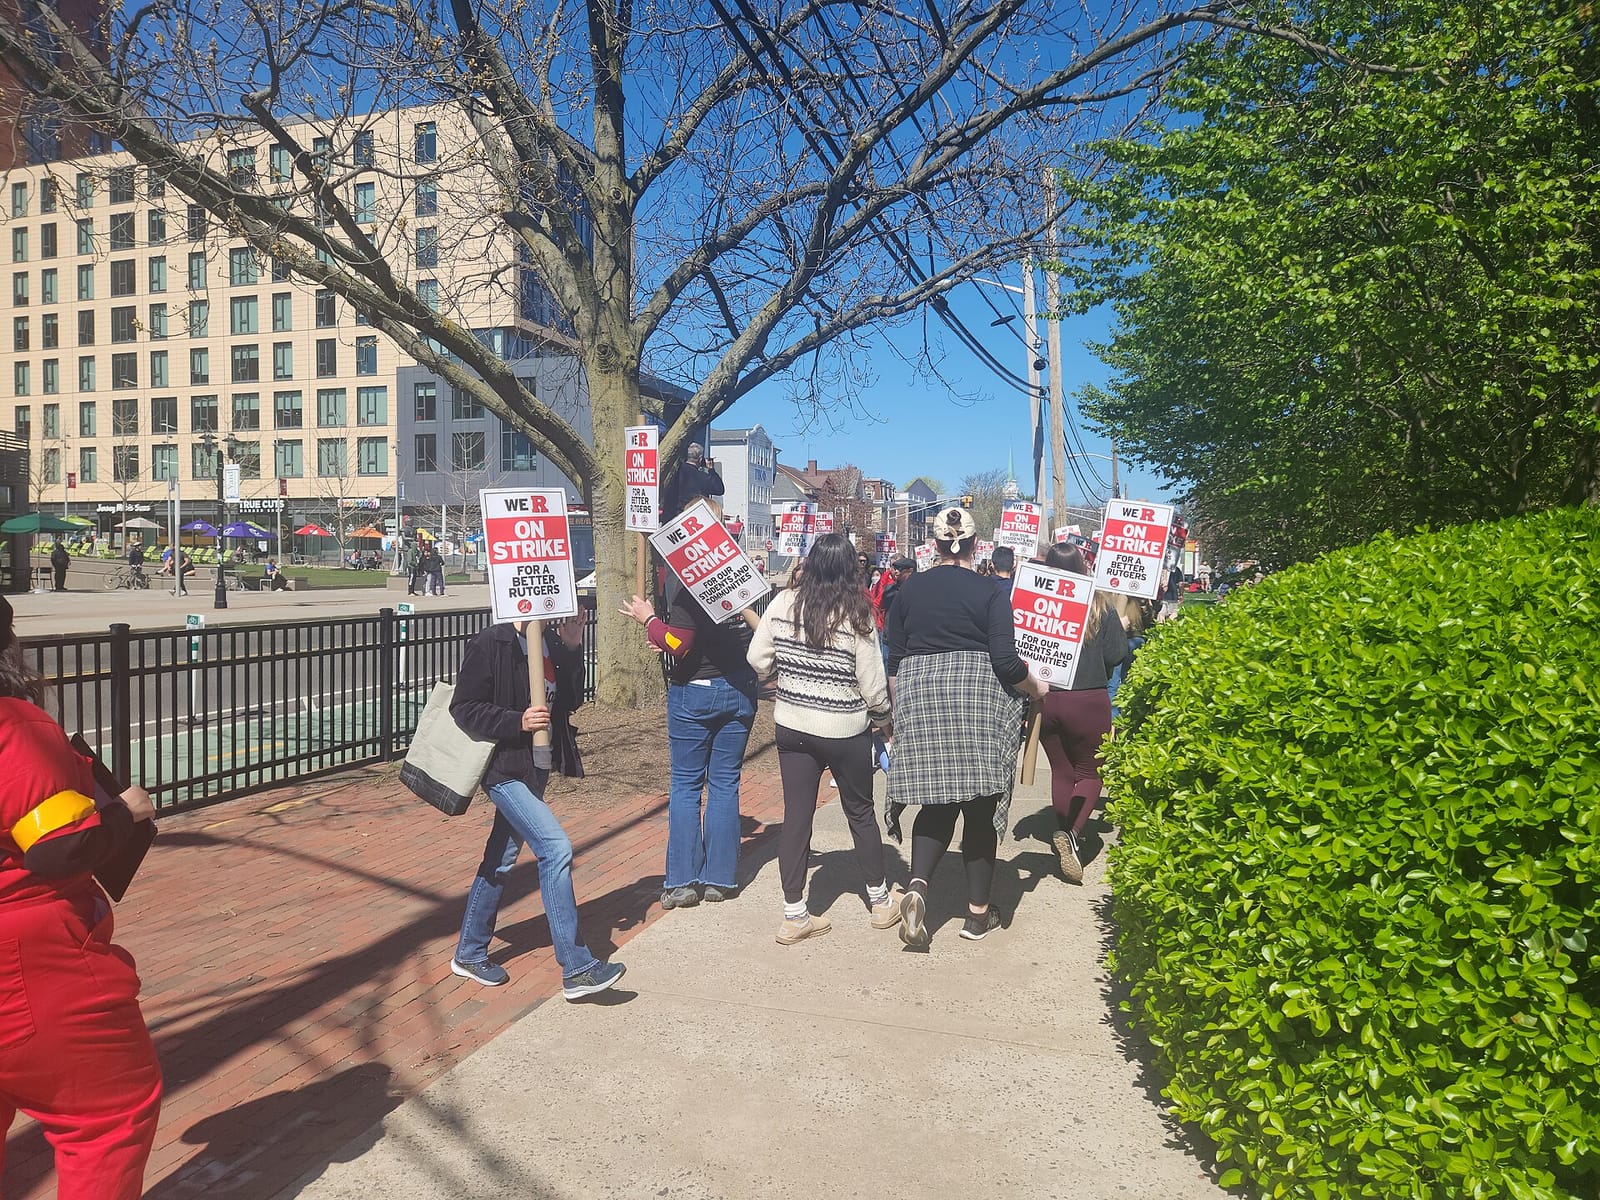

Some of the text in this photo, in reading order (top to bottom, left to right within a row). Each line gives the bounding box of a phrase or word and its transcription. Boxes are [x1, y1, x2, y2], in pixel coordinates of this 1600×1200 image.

[638, 432, 648, 447] R
[632, 452, 645, 468] ON
[627, 468, 655, 483] STRIKE
[641, 488, 646, 496] A
[240, 500, 285, 509] TRUE CUTS
[504, 495, 549, 513] WE R
[800, 505, 808, 513] R
[1012, 503, 1033, 513] WE R
[791, 515, 804, 523] ON
[1014, 514, 1029, 523] ON
[1122, 507, 1155, 522] WE R
[514, 520, 545, 539] ON
[666, 516, 704, 545] WE R
[782, 523, 813, 532] STRIKE
[1003, 521, 1037, 533] STRIKE
[1122, 523, 1147, 540] ON
[492, 539, 566, 560] STRIKE
[683, 538, 710, 561] ON
[1104, 534, 1162, 556] STRIKE
[681, 540, 736, 583] STRIKE
[1110, 560, 1145, 573] BETTER
[1116, 554, 1142, 565] FOR A
[517, 564, 550, 576] FOR A
[703, 566, 733, 589] FOR OUR
[1106, 567, 1147, 581] RUTGERS
[512, 575, 555, 587] BETTER
[699, 564, 749, 601] STUDENTS AND
[706, 572, 752, 605] COMMUNITIES
[1033, 575, 1075, 598] WE R
[509, 584, 560, 598] RUTGERS
[1033, 597, 1063, 618] ON
[1013, 608, 1080, 639] STRIKE
[1022, 633, 1060, 650] FOR OUR
[1015, 647, 1068, 668] OMMUNITIES
[1053, 650, 1073, 661] AND
